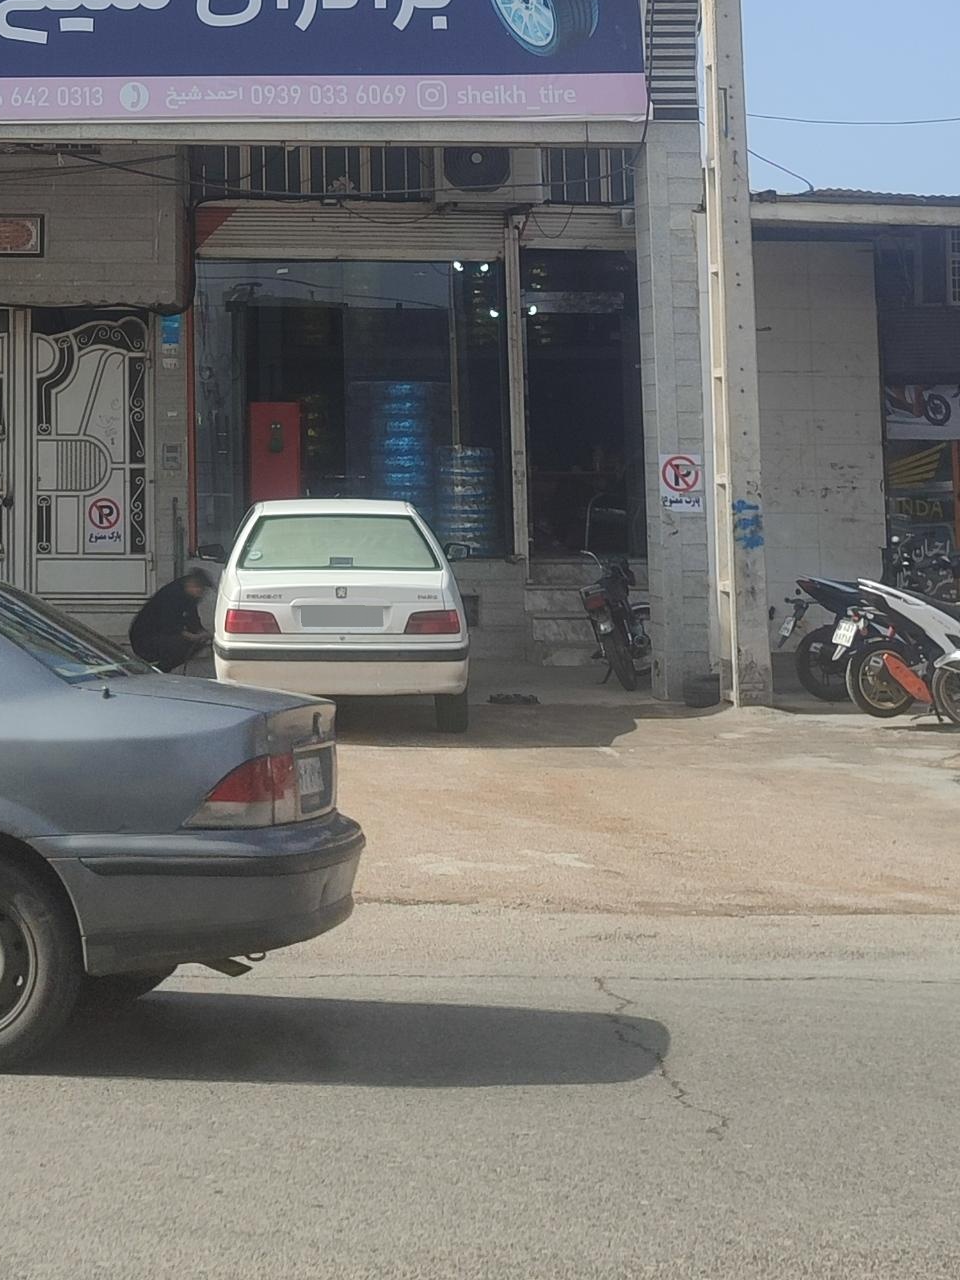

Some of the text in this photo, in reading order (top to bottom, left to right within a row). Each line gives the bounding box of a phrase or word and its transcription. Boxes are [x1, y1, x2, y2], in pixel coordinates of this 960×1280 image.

[11, 86, 50, 107] 642
[57, 86, 104, 106] 0313
[165, 84, 407, 109] 0939 033 6069 احمد شیخ
[457, 84, 577, 110] sheikh_tire
[89, 530, 122, 543] پارک ممنوع
